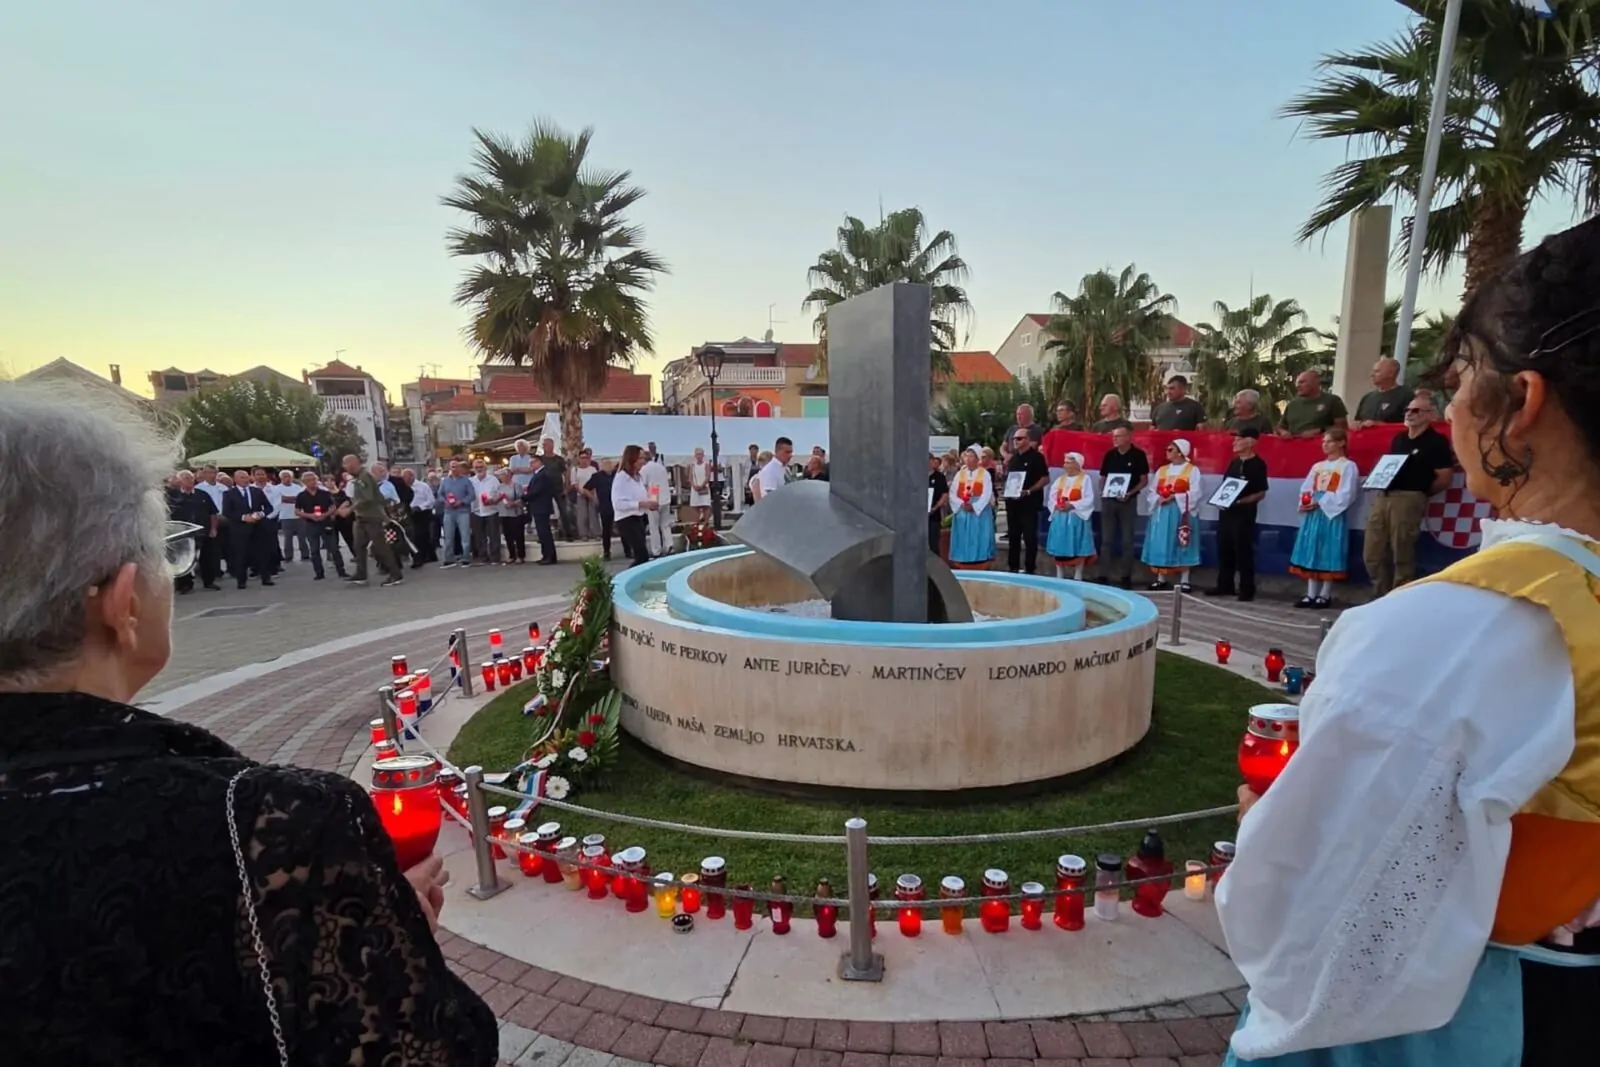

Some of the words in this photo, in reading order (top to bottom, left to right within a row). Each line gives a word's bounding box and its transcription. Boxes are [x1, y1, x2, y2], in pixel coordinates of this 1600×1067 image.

[661, 640, 677, 656] IVE
[680, 644, 727, 664] PERKOV
[743, 657, 780, 672] ANTE
[785, 658, 851, 677] JURIČEV
[871, 663, 966, 681] MARTINČEV
[988, 660, 1067, 681] LEONARDO
[1073, 650, 1121, 672] MAČUKAT
[677, 716, 706, 734] NAŠA
[713, 724, 765, 745] ZEMLJO
